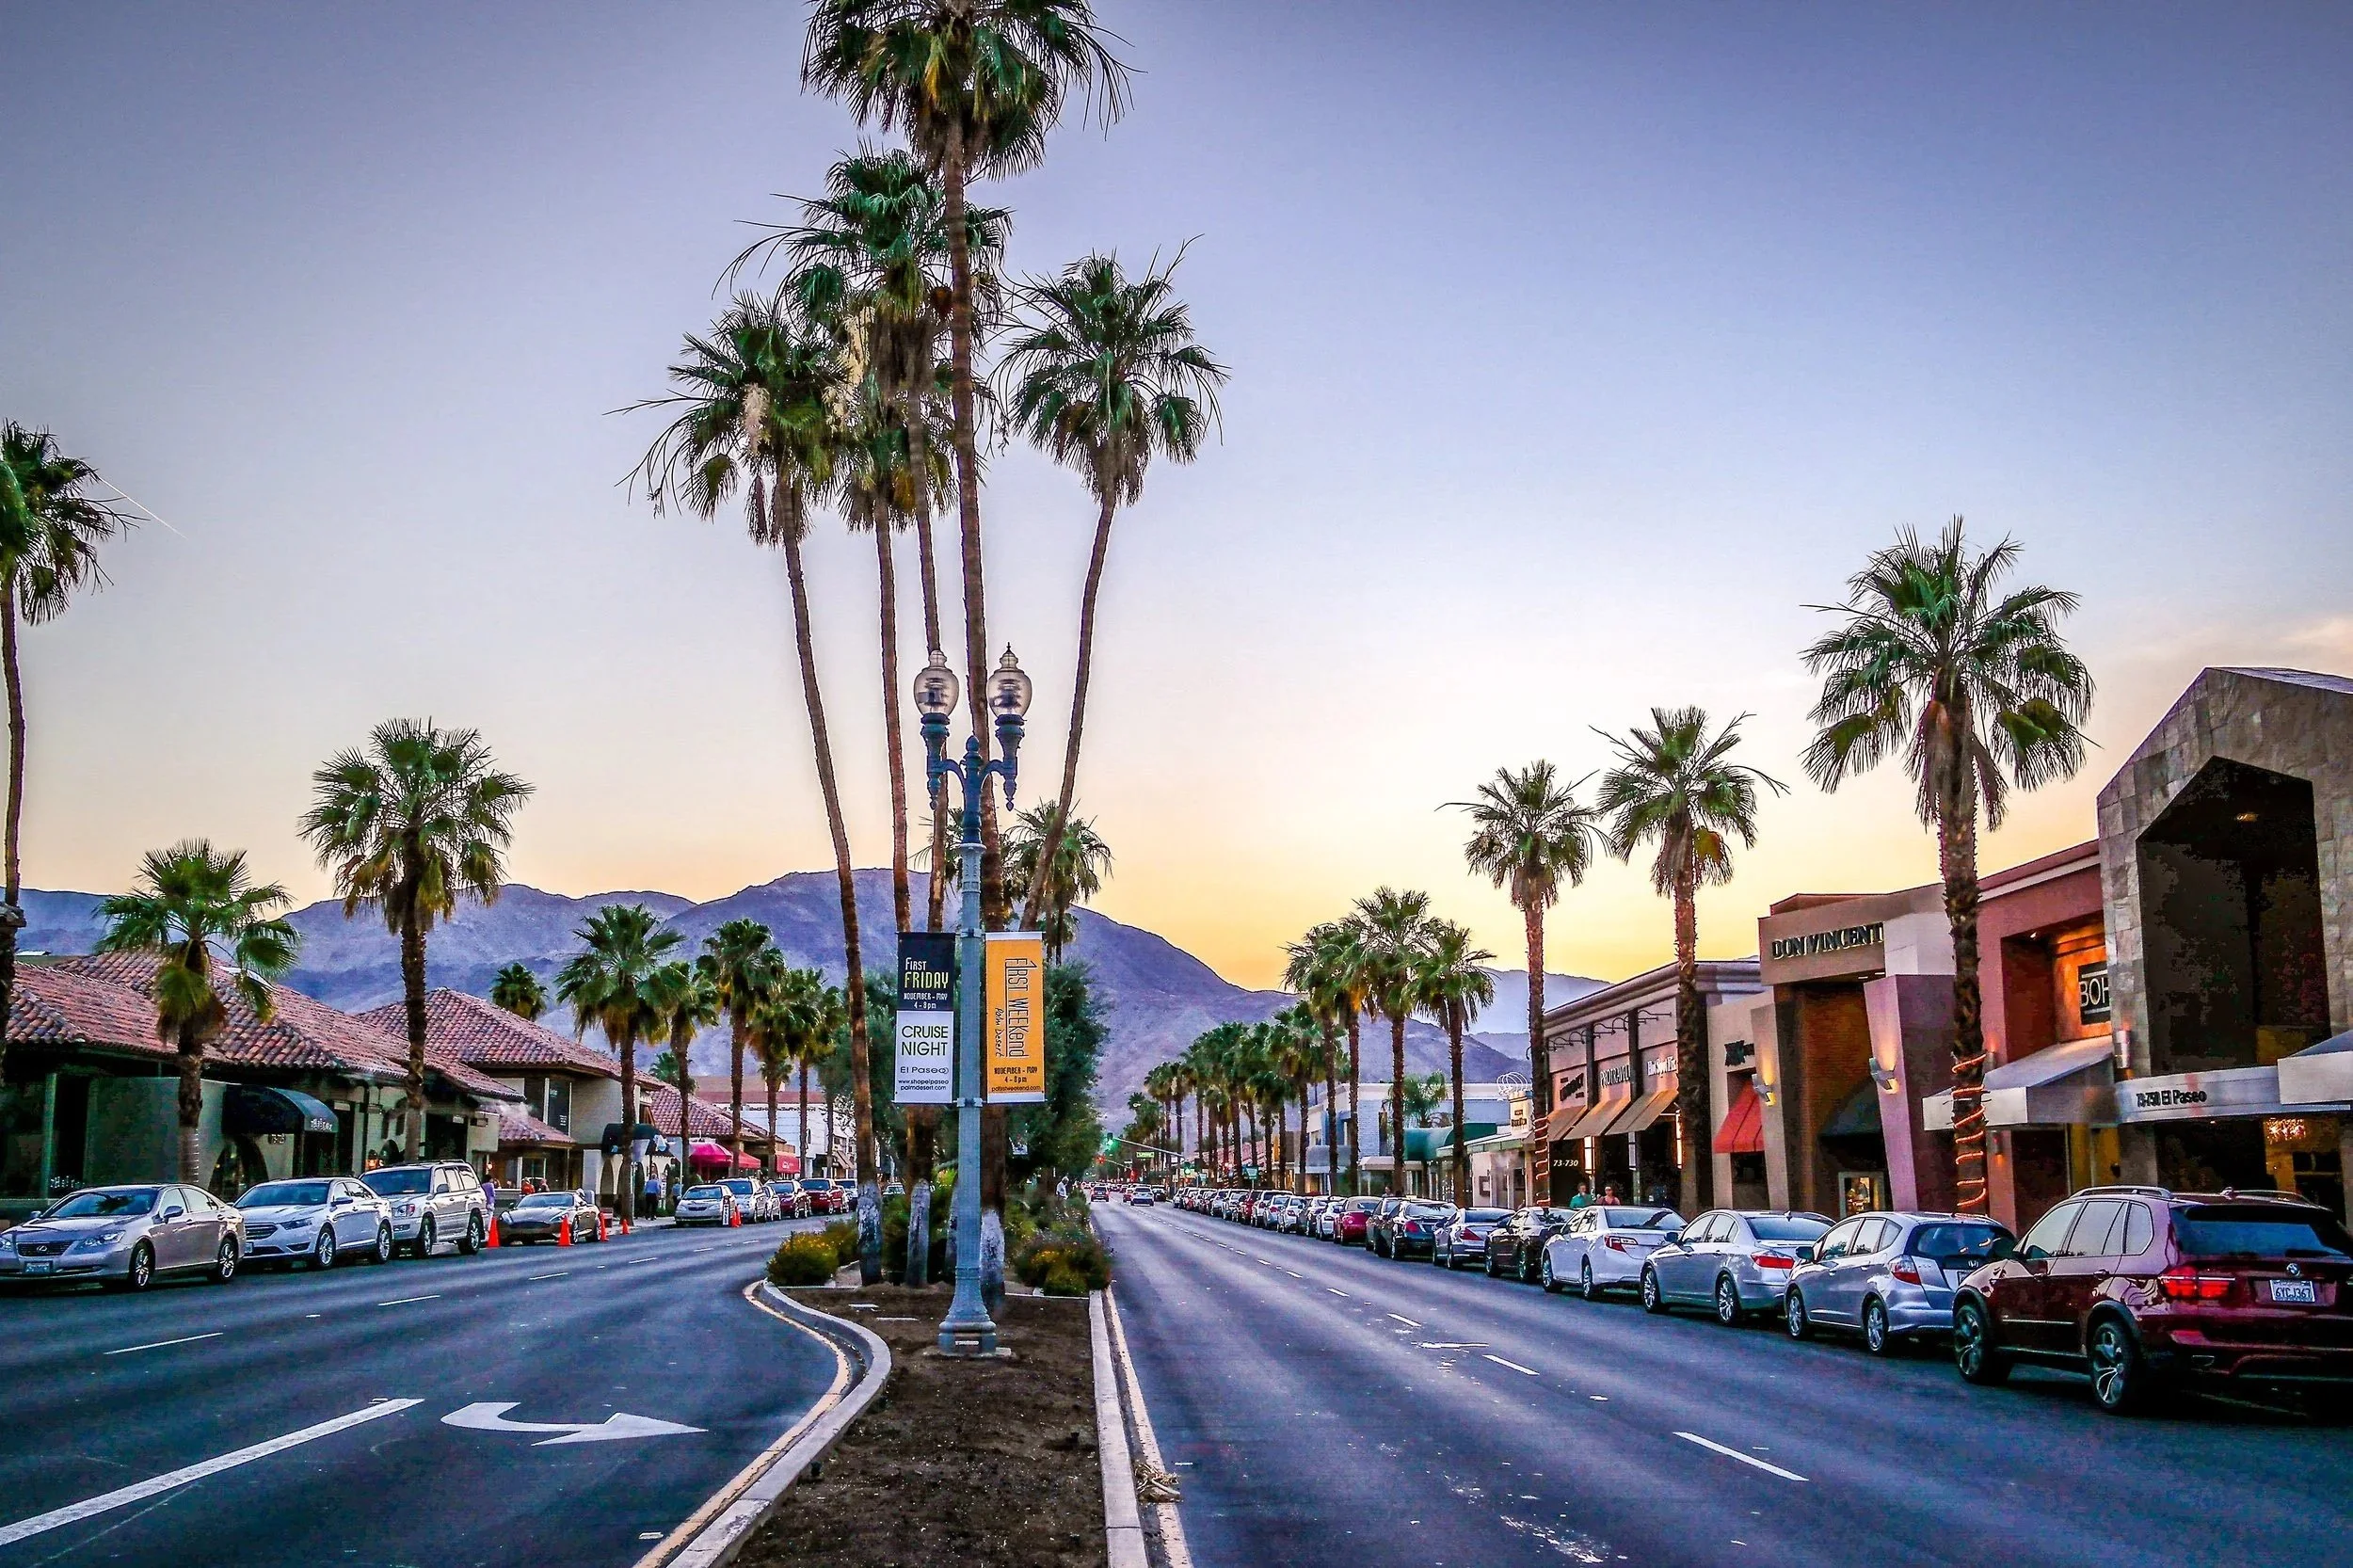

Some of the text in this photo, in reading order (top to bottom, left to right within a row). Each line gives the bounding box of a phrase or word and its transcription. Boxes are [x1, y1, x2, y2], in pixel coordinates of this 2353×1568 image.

[1772, 936, 1807, 959] DON
[905, 957, 927, 970] FIRST
[904, 972, 949, 988] FRIDAY
[923, 1001, 936, 1010] 8pm
[902, 1025, 949, 1039] CRUISE
[902, 1041, 949, 1056] NIGHT
[995, 1029, 1004, 1057] Desert
[912, 1066, 950, 1075] Paseo
[2172, 1090, 2208, 1105] Paseo
[1553, 1159, 1579, 1167] 73-730
